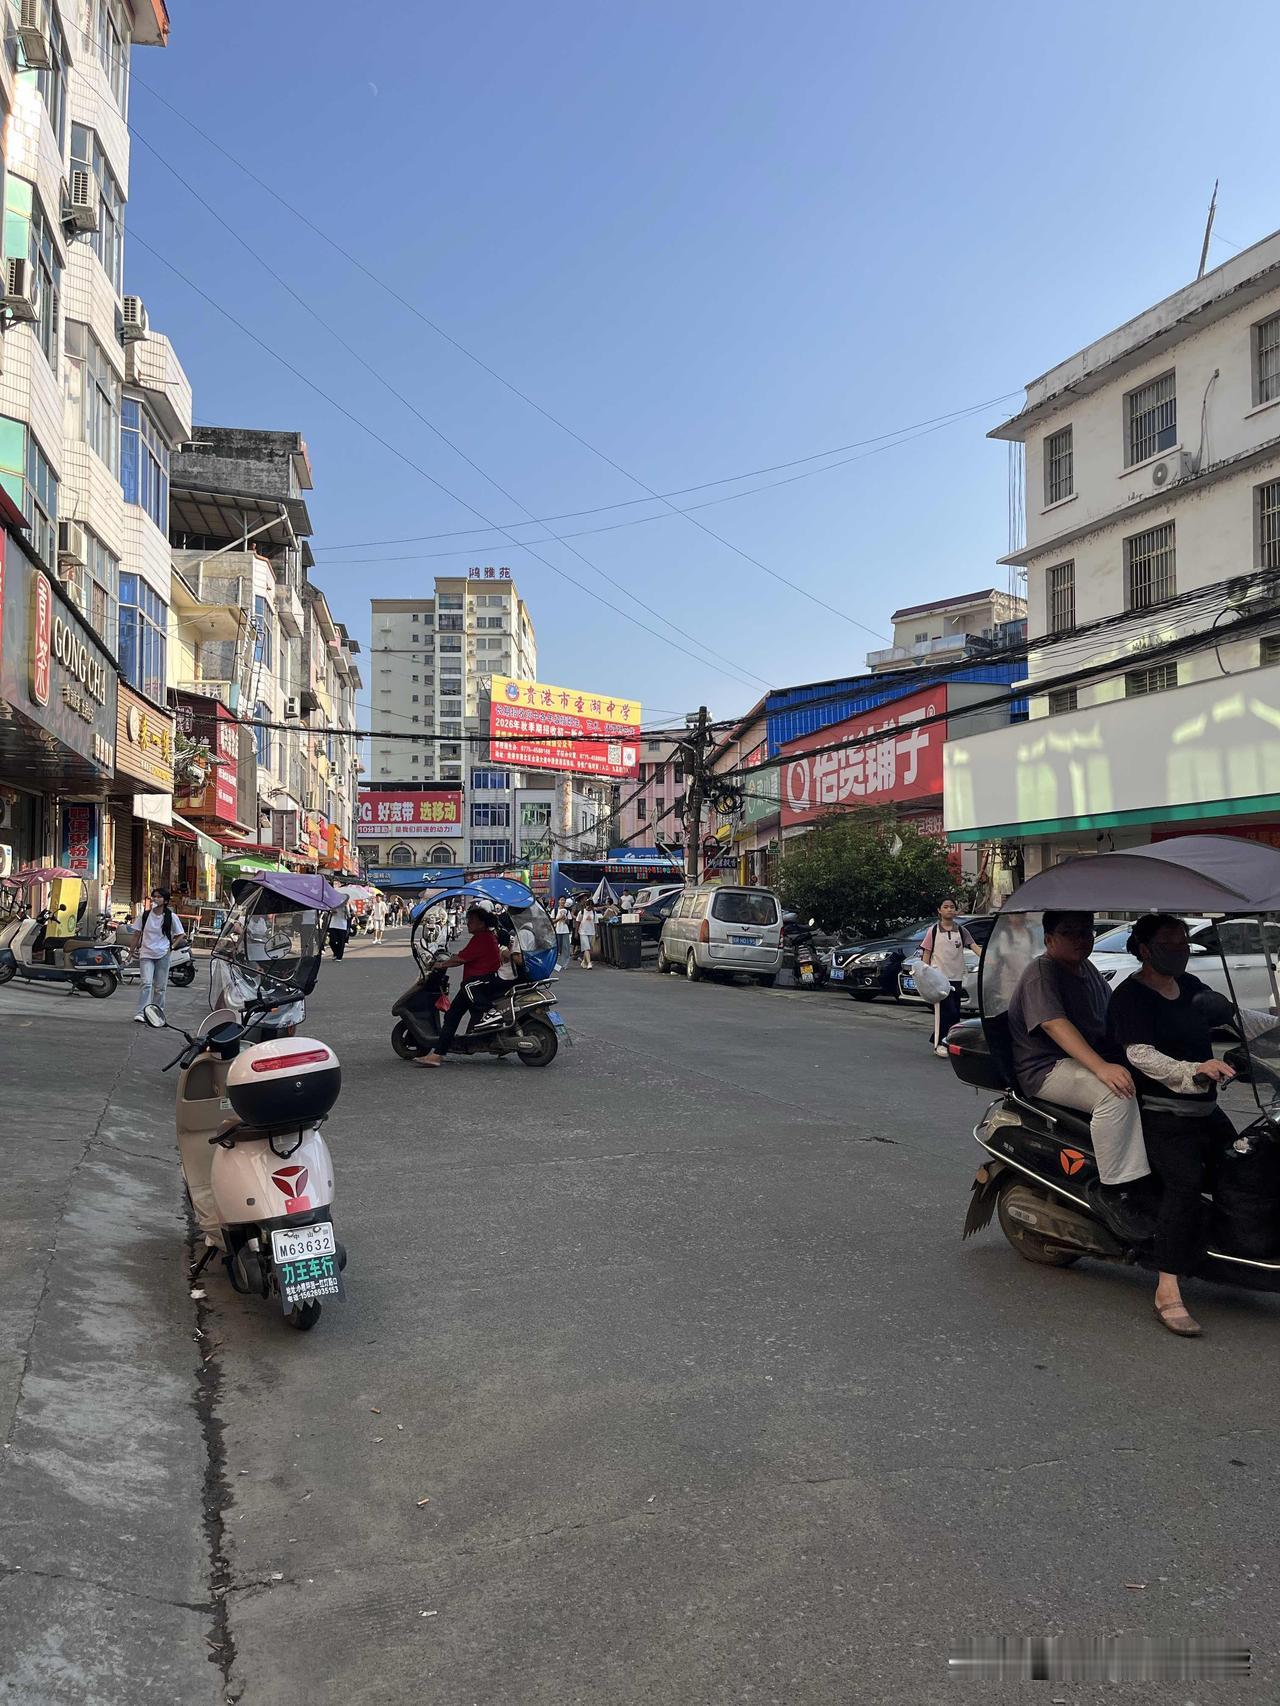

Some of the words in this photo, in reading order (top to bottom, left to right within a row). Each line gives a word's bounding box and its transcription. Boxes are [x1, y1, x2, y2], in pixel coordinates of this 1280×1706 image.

[54, 615, 87, 684] GONG
[88, 656, 106, 706] CHA
[378, 801, 415, 822] 好宽带
[420, 801, 457, 822] 选移动
[280, 1237, 331, 1258] M63632
[282, 1256, 335, 1286] 力王车行
